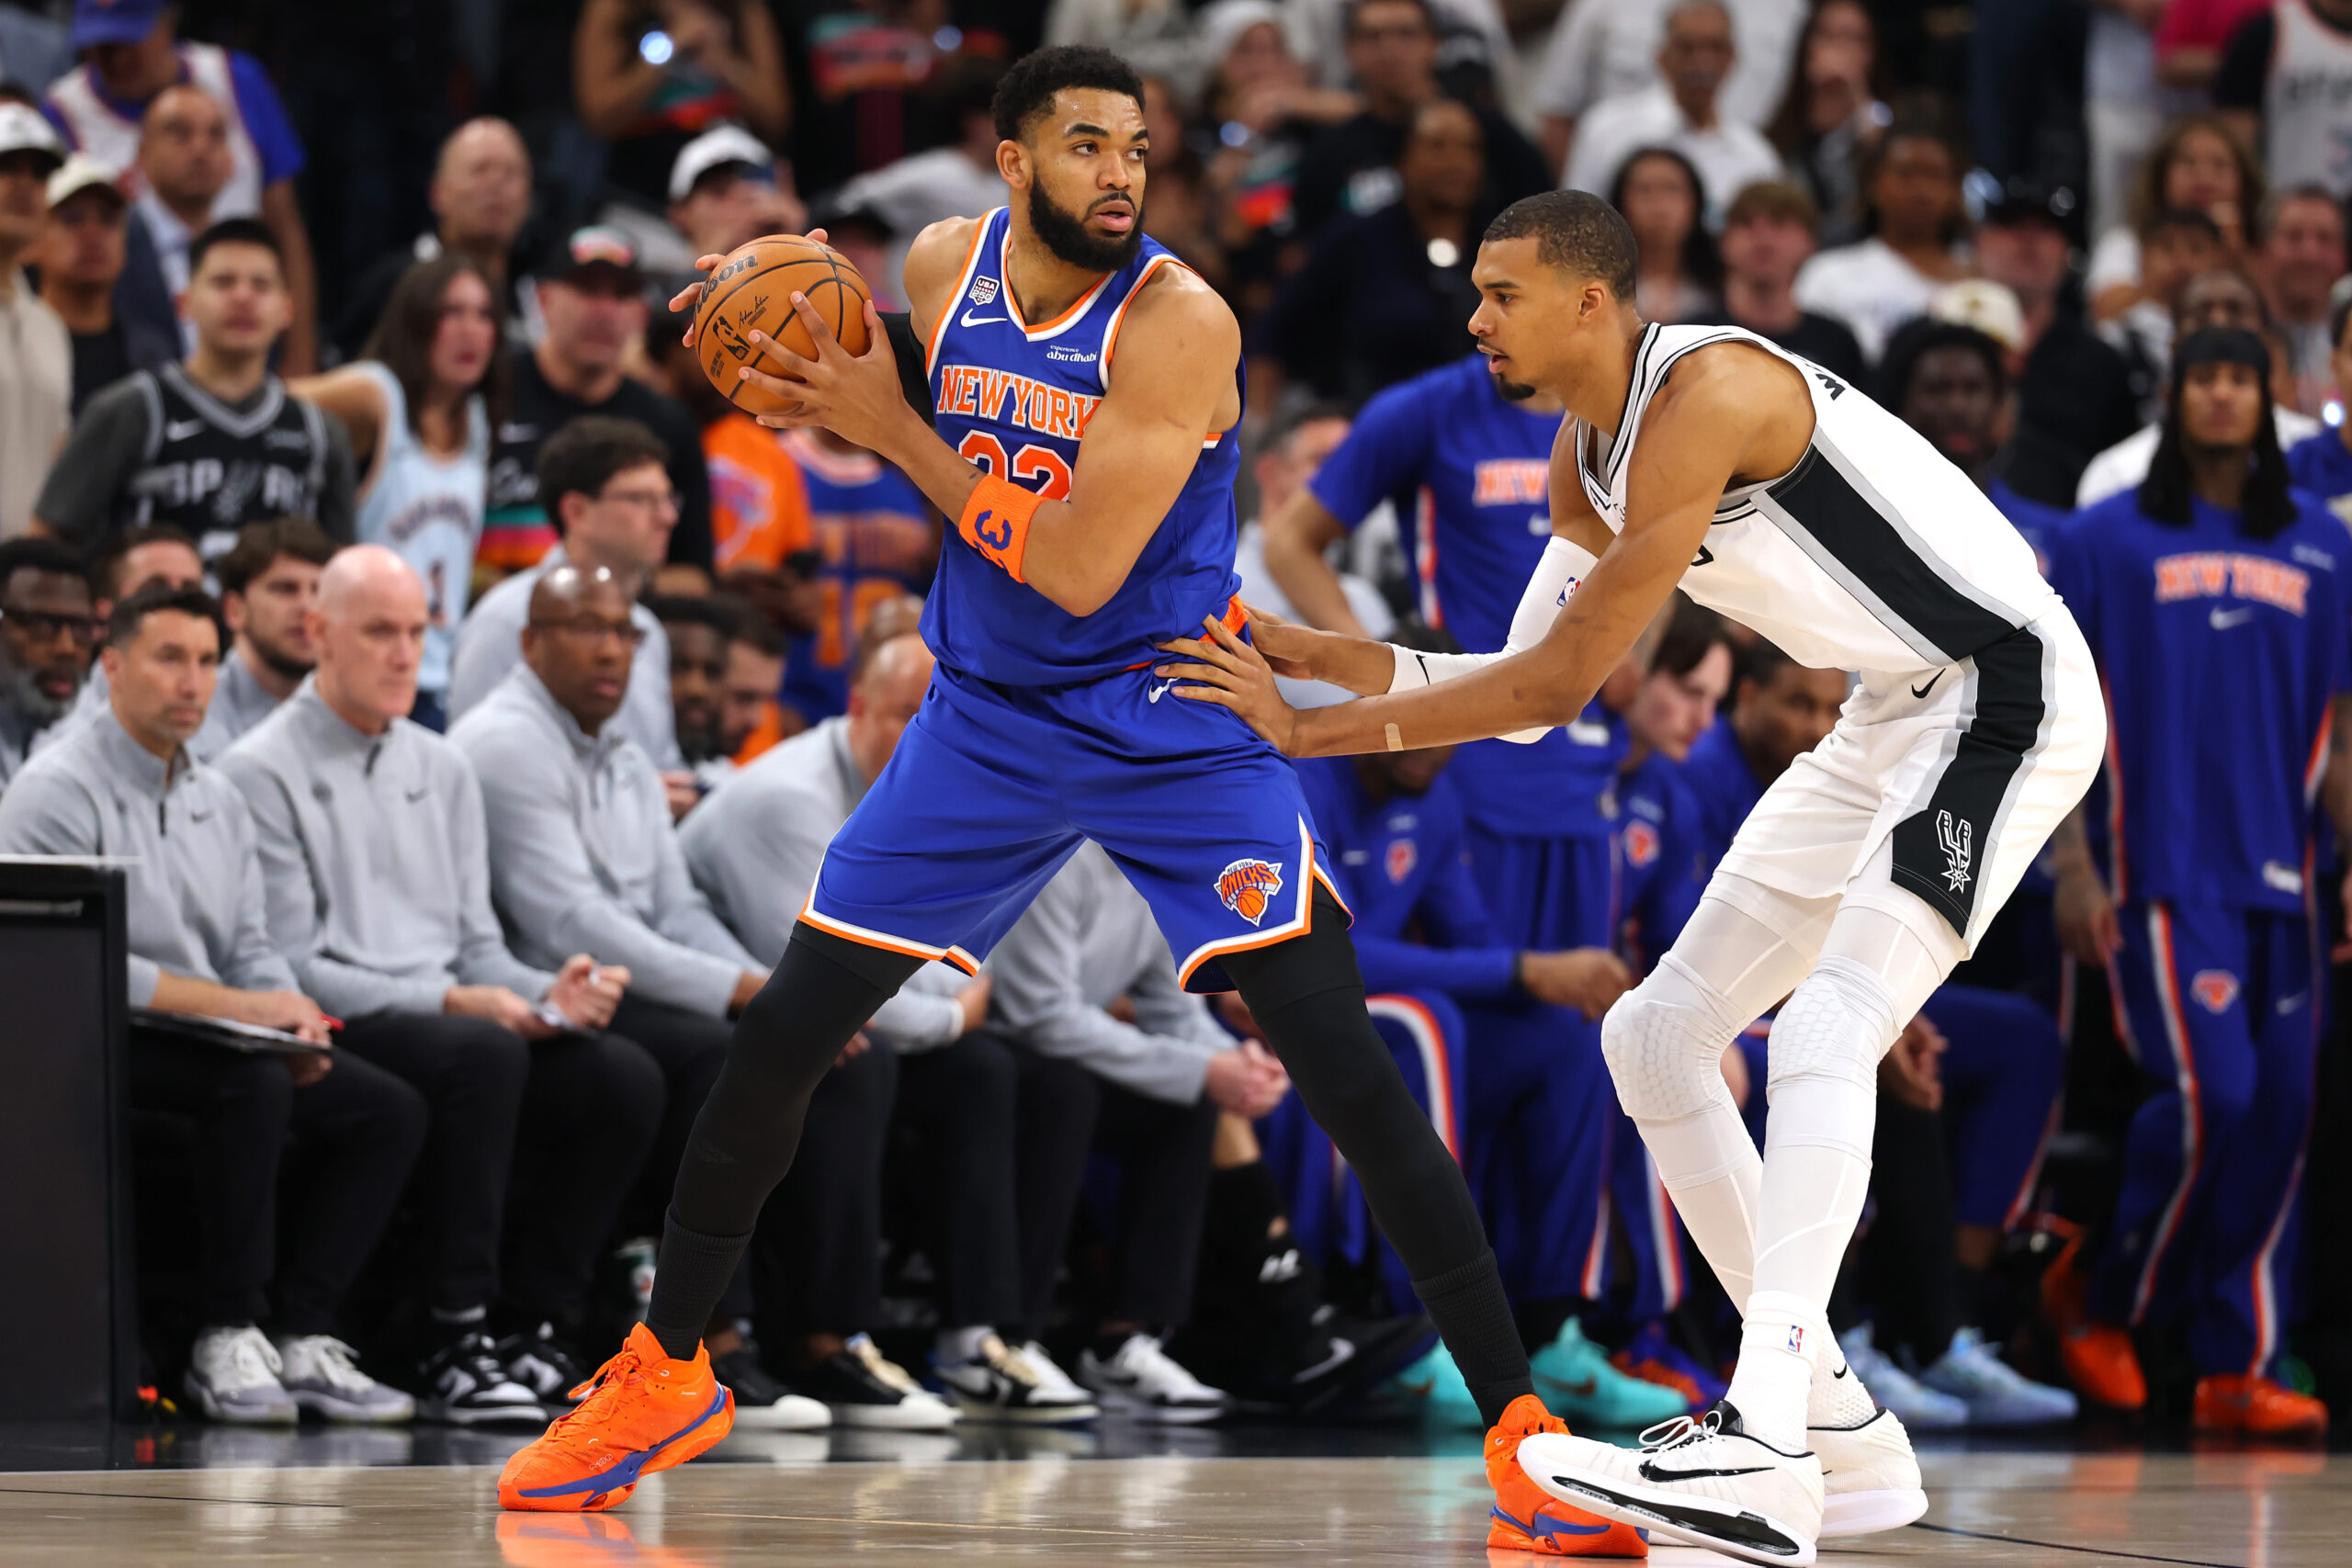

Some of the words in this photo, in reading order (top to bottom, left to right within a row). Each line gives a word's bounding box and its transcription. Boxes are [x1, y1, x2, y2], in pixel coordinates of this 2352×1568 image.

[977, 279, 995, 290] USA
[1046, 351, 1069, 361] abu
[1069, 351, 1098, 363] dhabi
[936, 364, 1012, 421] NEW
[1011, 377, 1105, 442] YORK
[2154, 551, 2227, 604] NEW
[2229, 552, 2311, 618] YORK
[1221, 863, 1280, 903] KNICKS
